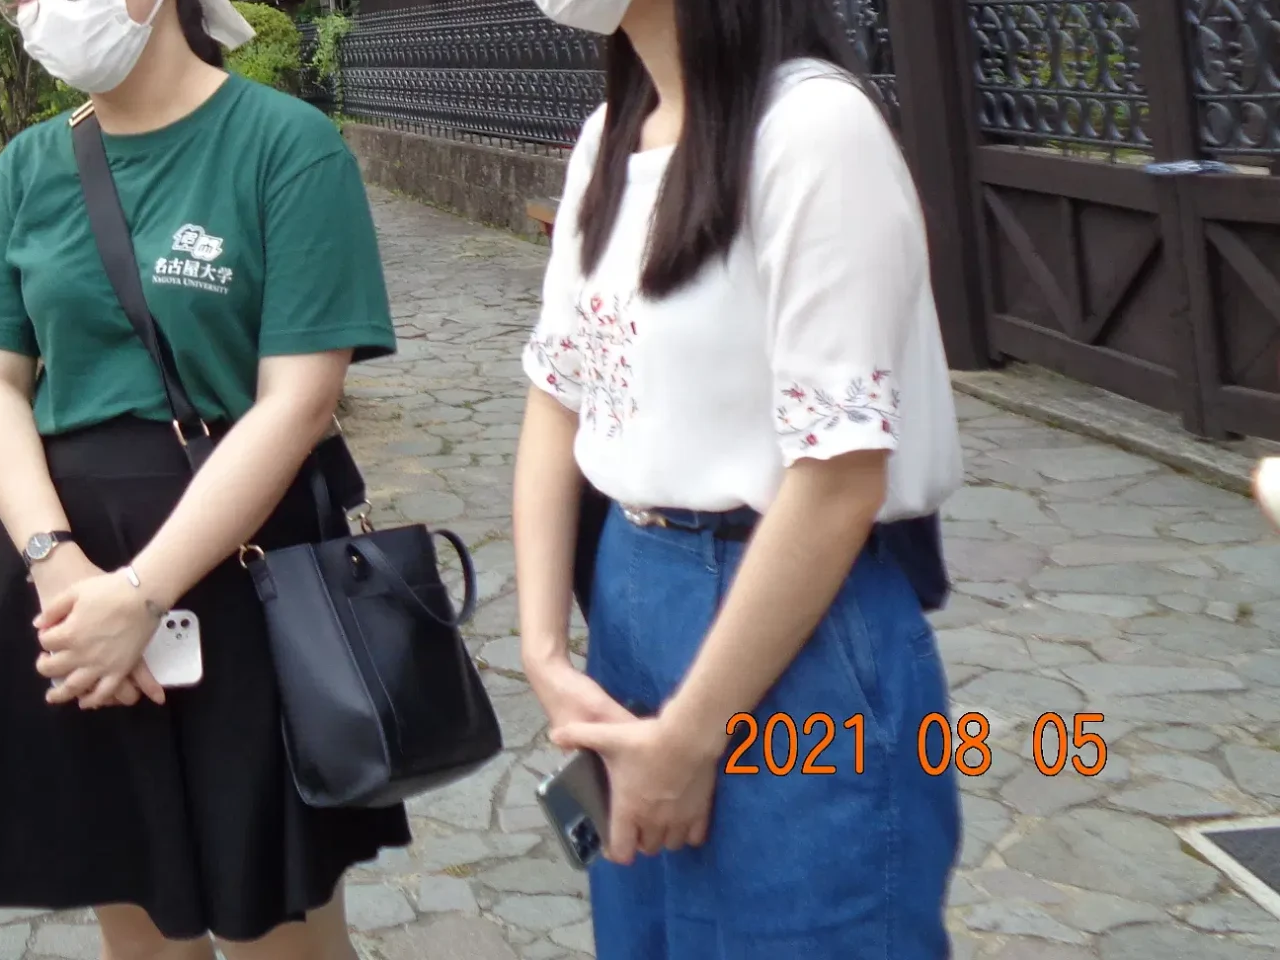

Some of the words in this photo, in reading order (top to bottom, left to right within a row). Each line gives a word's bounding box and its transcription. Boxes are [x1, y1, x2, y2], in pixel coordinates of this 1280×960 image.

[155, 257, 233, 284] 名古屋大学
[152, 275, 181, 285] NAGOYA
[183, 277, 229, 295] UNIVERSITY
